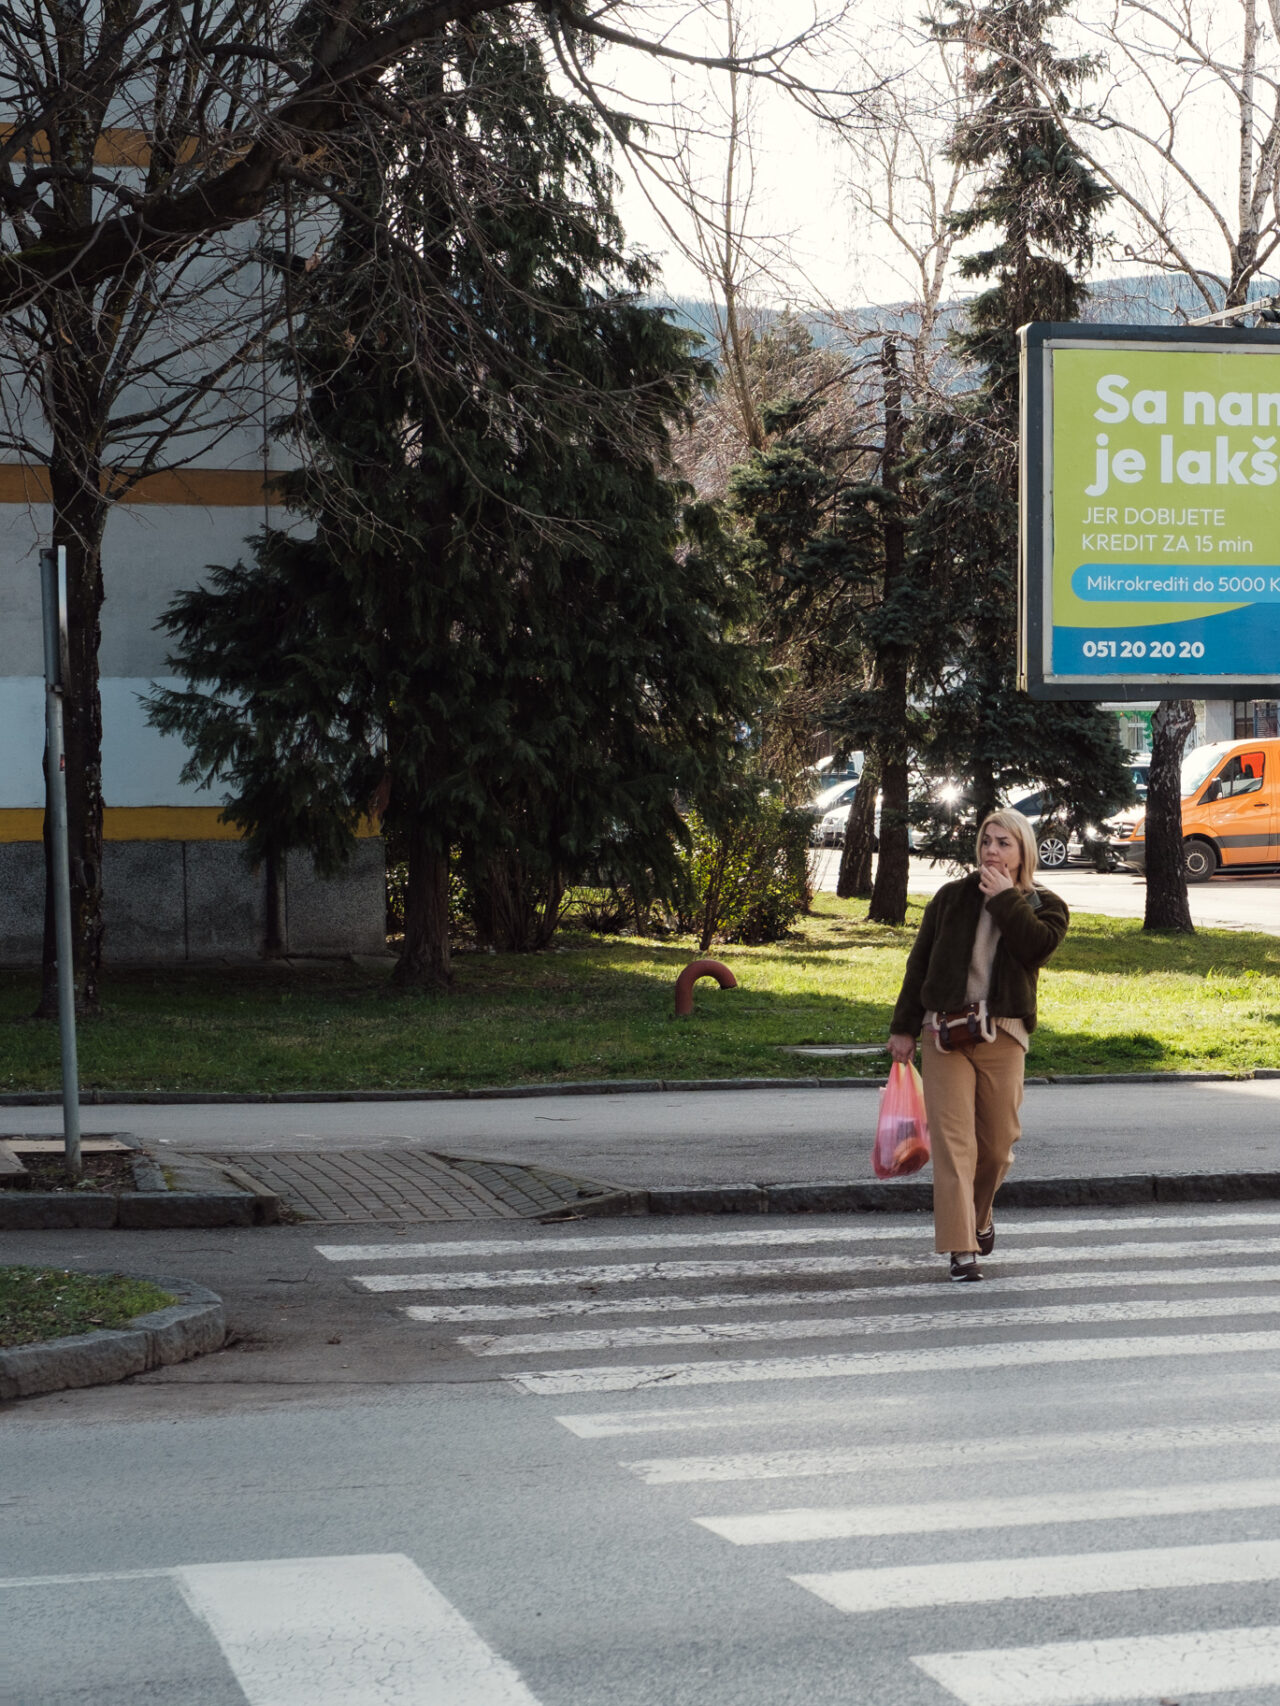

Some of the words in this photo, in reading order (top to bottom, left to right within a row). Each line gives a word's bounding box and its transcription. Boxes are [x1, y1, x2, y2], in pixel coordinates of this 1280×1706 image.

[1093, 374, 1167, 424] Sa
[1084, 433, 1146, 497] je
[1082, 507, 1119, 525] JER
[1124, 508, 1226, 526] DOBIJETE
[1082, 534, 1158, 551] KREDIT
[1163, 535, 1190, 552] ZA
[1195, 536, 1213, 552] 15
[1218, 536, 1253, 552] min
[1087, 575, 1189, 592] Mikrokrediti
[1193, 576, 1214, 592] do
[1218, 577, 1265, 592] 5000
[1082, 640, 1116, 658] 051
[1120, 641, 1146, 658] 20
[1150, 641, 1176, 658] 20
[1179, 641, 1205, 658] 20
